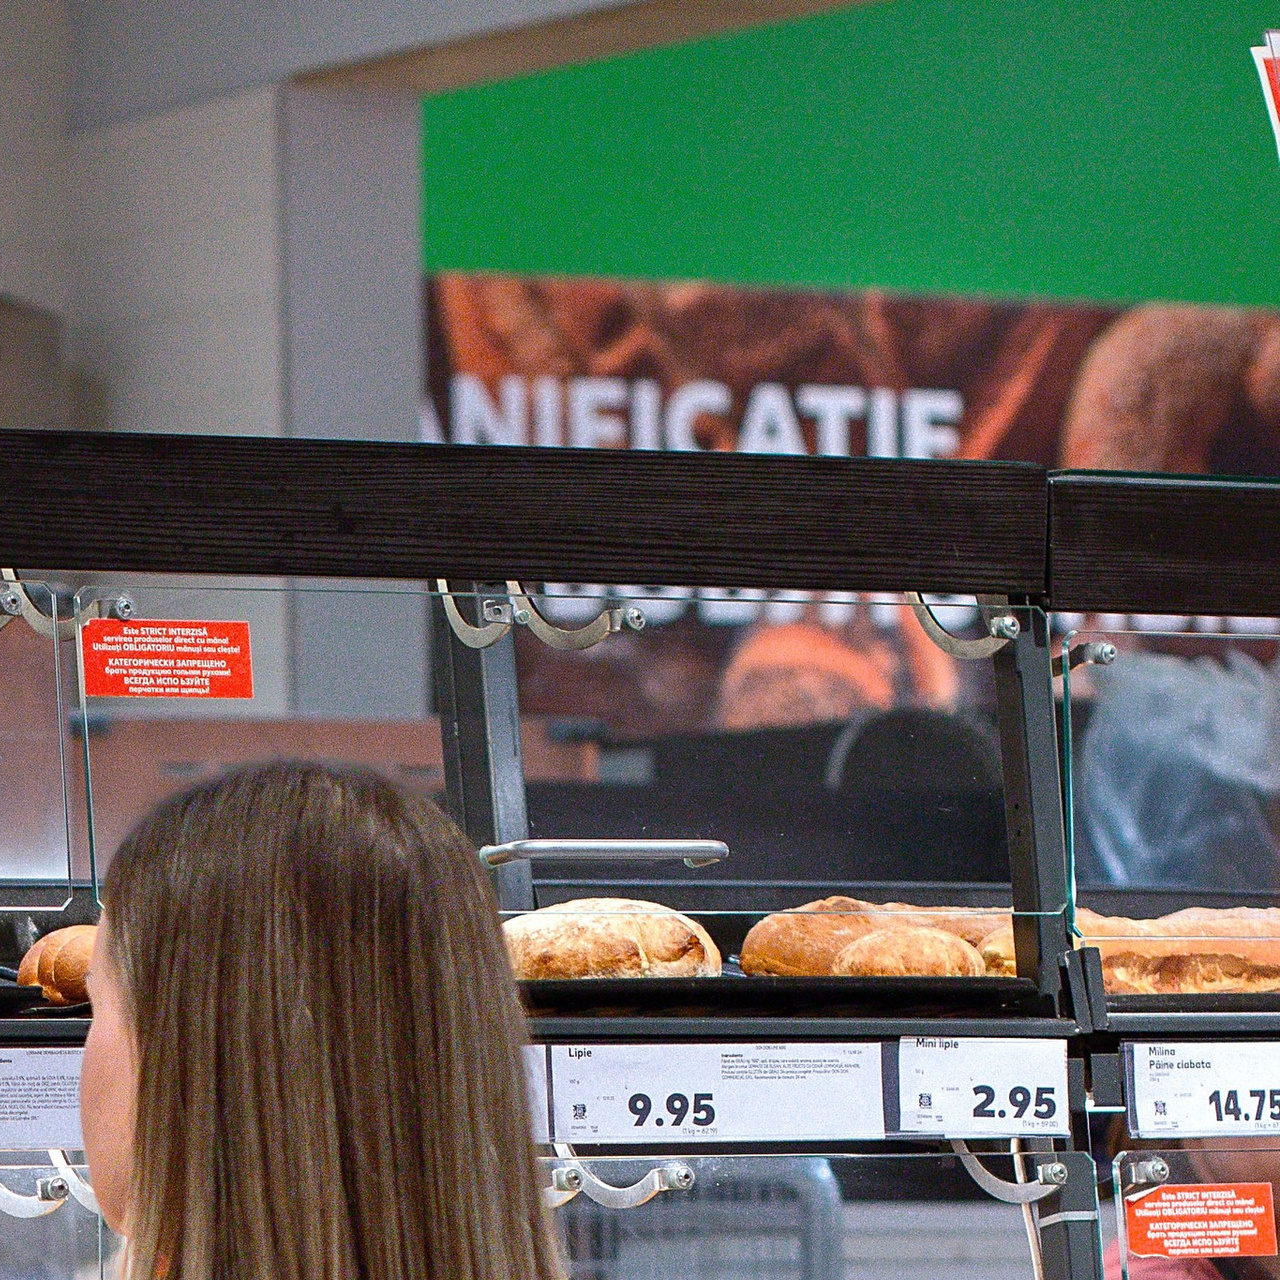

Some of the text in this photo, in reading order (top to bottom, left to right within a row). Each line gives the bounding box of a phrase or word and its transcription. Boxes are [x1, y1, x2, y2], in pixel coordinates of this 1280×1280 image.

[124, 627, 139, 635] Este
[169, 627, 207, 636] INTERZISĂ
[134, 636, 172, 644] produselor
[123, 644, 174, 652] OBLIGATORIU
[109, 658, 226, 668] КАТЕГОРИЧЕСКИ ЗАПРЕЩЕНО
[124, 677, 155, 685] ВСЕГДА
[916, 1038, 936, 1048] Mini
[569, 1048, 592, 1059] Lipie
[1149, 1047, 1175, 1056] Milina
[1149, 1060, 1211, 1069] Pâine ciabata
[973, 1085, 1056, 1119] 2.95
[1209, 1090, 1280, 1121] 14.75
[628, 1093, 715, 1127] 9.95
